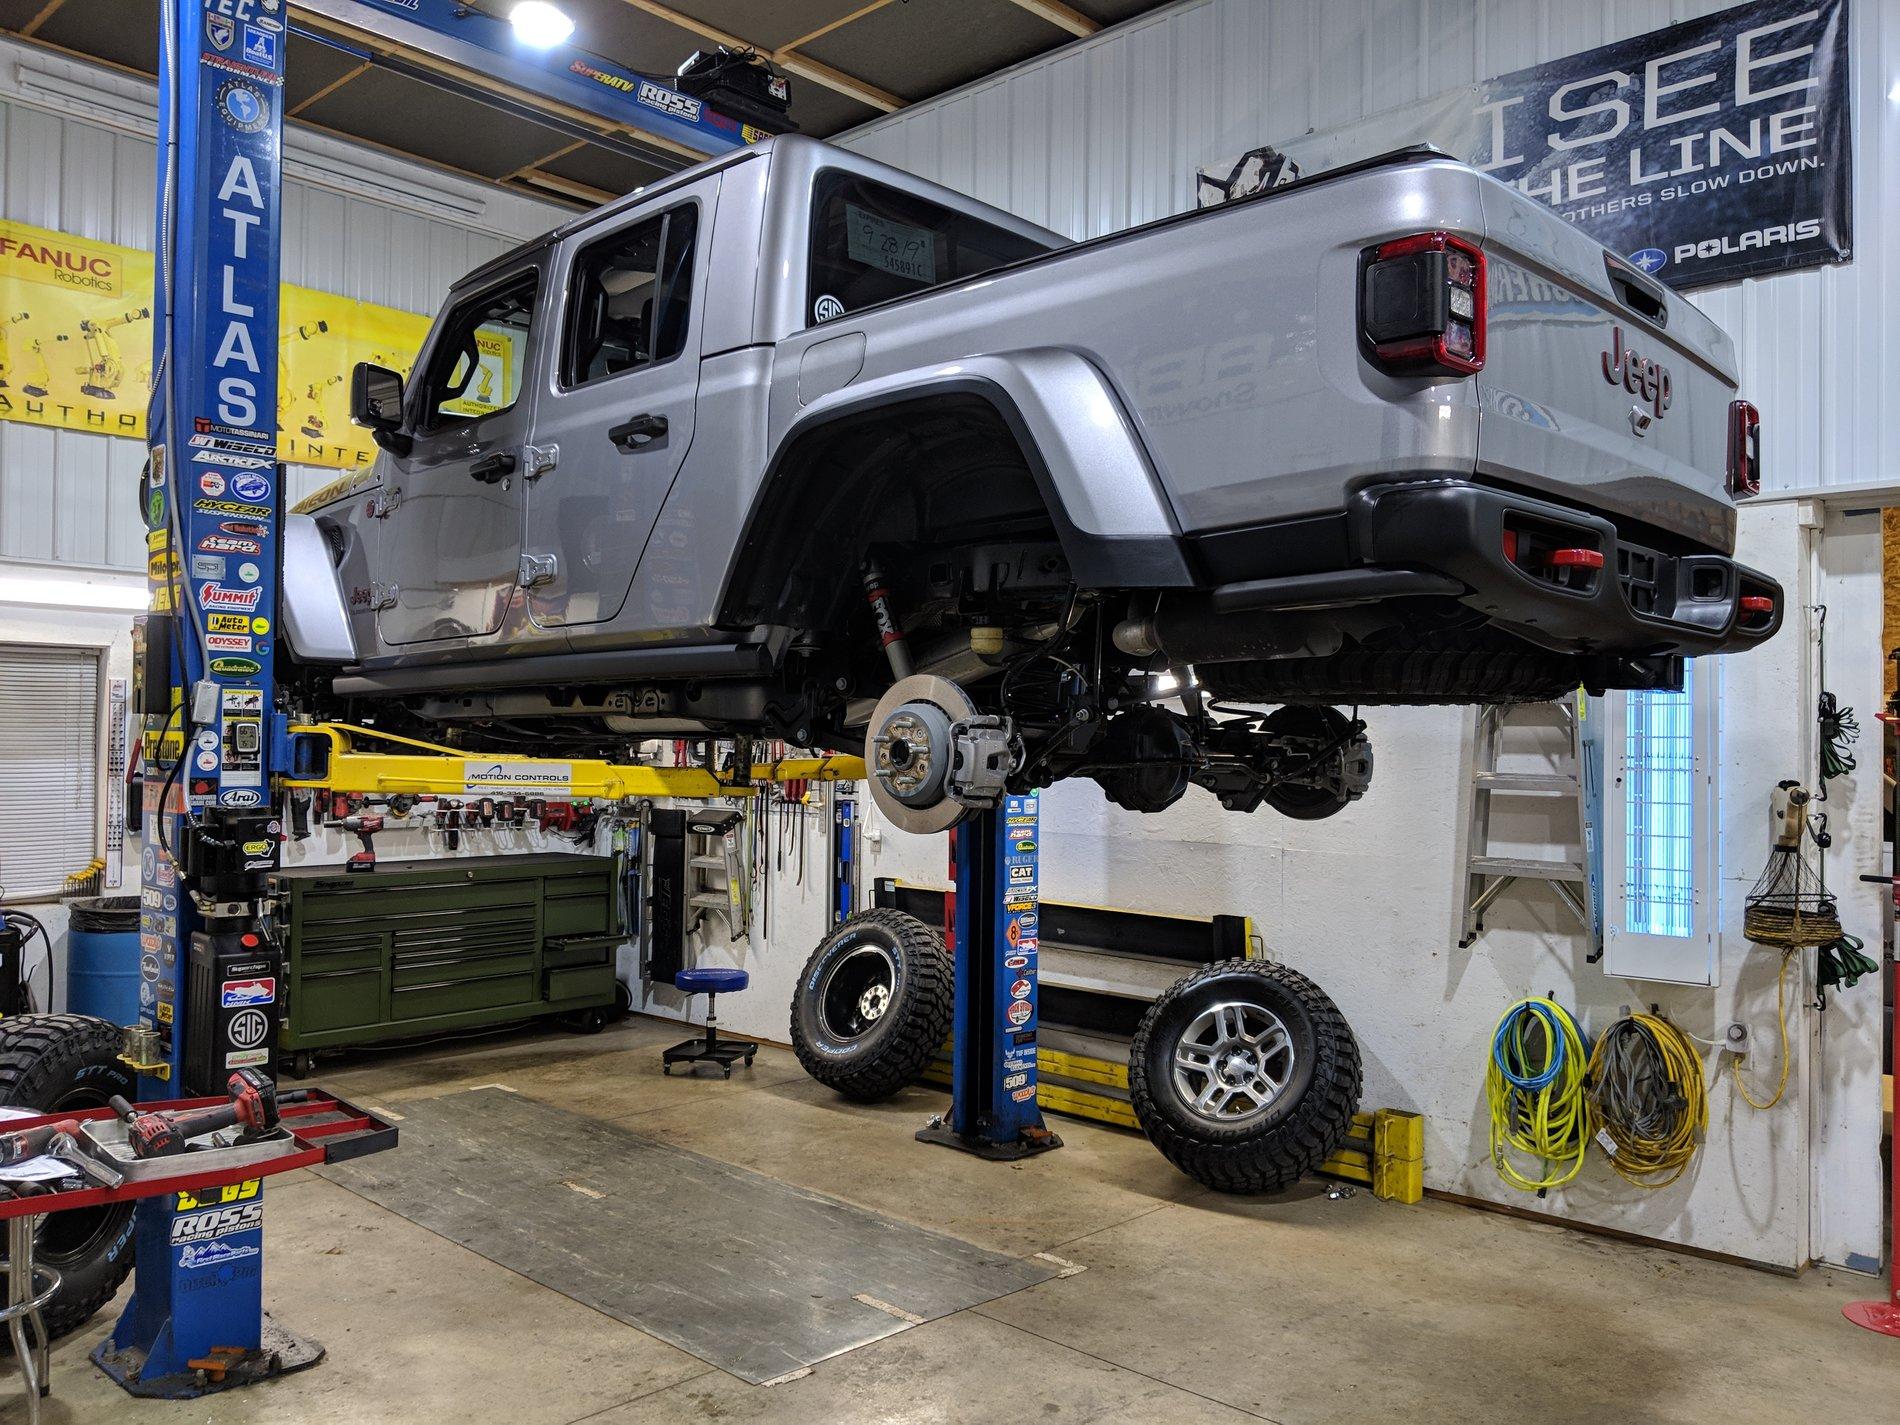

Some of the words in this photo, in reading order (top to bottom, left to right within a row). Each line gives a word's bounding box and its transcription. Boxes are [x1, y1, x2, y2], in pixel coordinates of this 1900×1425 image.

[200, 58, 276, 85] PERFORMANCE
[570, 60, 634, 92] SUPERATV
[228, 81, 260, 98] ATLAS
[641, 84, 698, 114] ROSS
[1473, 96, 1524, 172] I
[1548, 10, 1819, 151] SEE
[640, 97, 668, 110] racing
[668, 105, 697, 120] pistons
[1505, 157, 1606, 206] HE
[1630, 105, 1817, 186] LINE
[1660, 176, 1730, 201] SLOW
[1739, 156, 1825, 184] DOWN.
[1674, 218, 1821, 264] POLARIS
[0, 237, 112, 278] FANUC
[54, 268, 112, 292] Robotics
[213, 155, 264, 427] ATLAS
[477, 340, 501, 351] NUC
[1601, 326, 1673, 419] Jeep
[210, 424, 269, 440] MOTOTASSINARI
[213, 438, 277, 456] WISECO
[196, 499, 271, 517] HYGEAR
[196, 508, 265, 521] SUSPENSION
[203, 585, 256, 604] SUMMIT
[219, 623, 248, 631] Meter
[221, 616, 244, 624] Auto
[871, 597, 894, 640] FOX
[208, 636, 250, 646] ODYSSEY
[144, 732, 180, 760] Pretone
[514, 774, 569, 782] CONTROLS
[225, 791, 255, 802] Arai
[1011, 867, 1032, 878] CAT
[143, 888, 161, 909] 509
[808, 932, 857, 990] DISCOVERER
[233, 1013, 263, 1044] SIG
[75, 1065, 107, 1080] STT
[106, 1070, 128, 1085] PRO
[1006, 1073, 1026, 1089] 509
[171, 1230, 213, 1244] racing
[214, 1219, 262, 1237] pistons
[172, 1205, 263, 1237] ROSS
